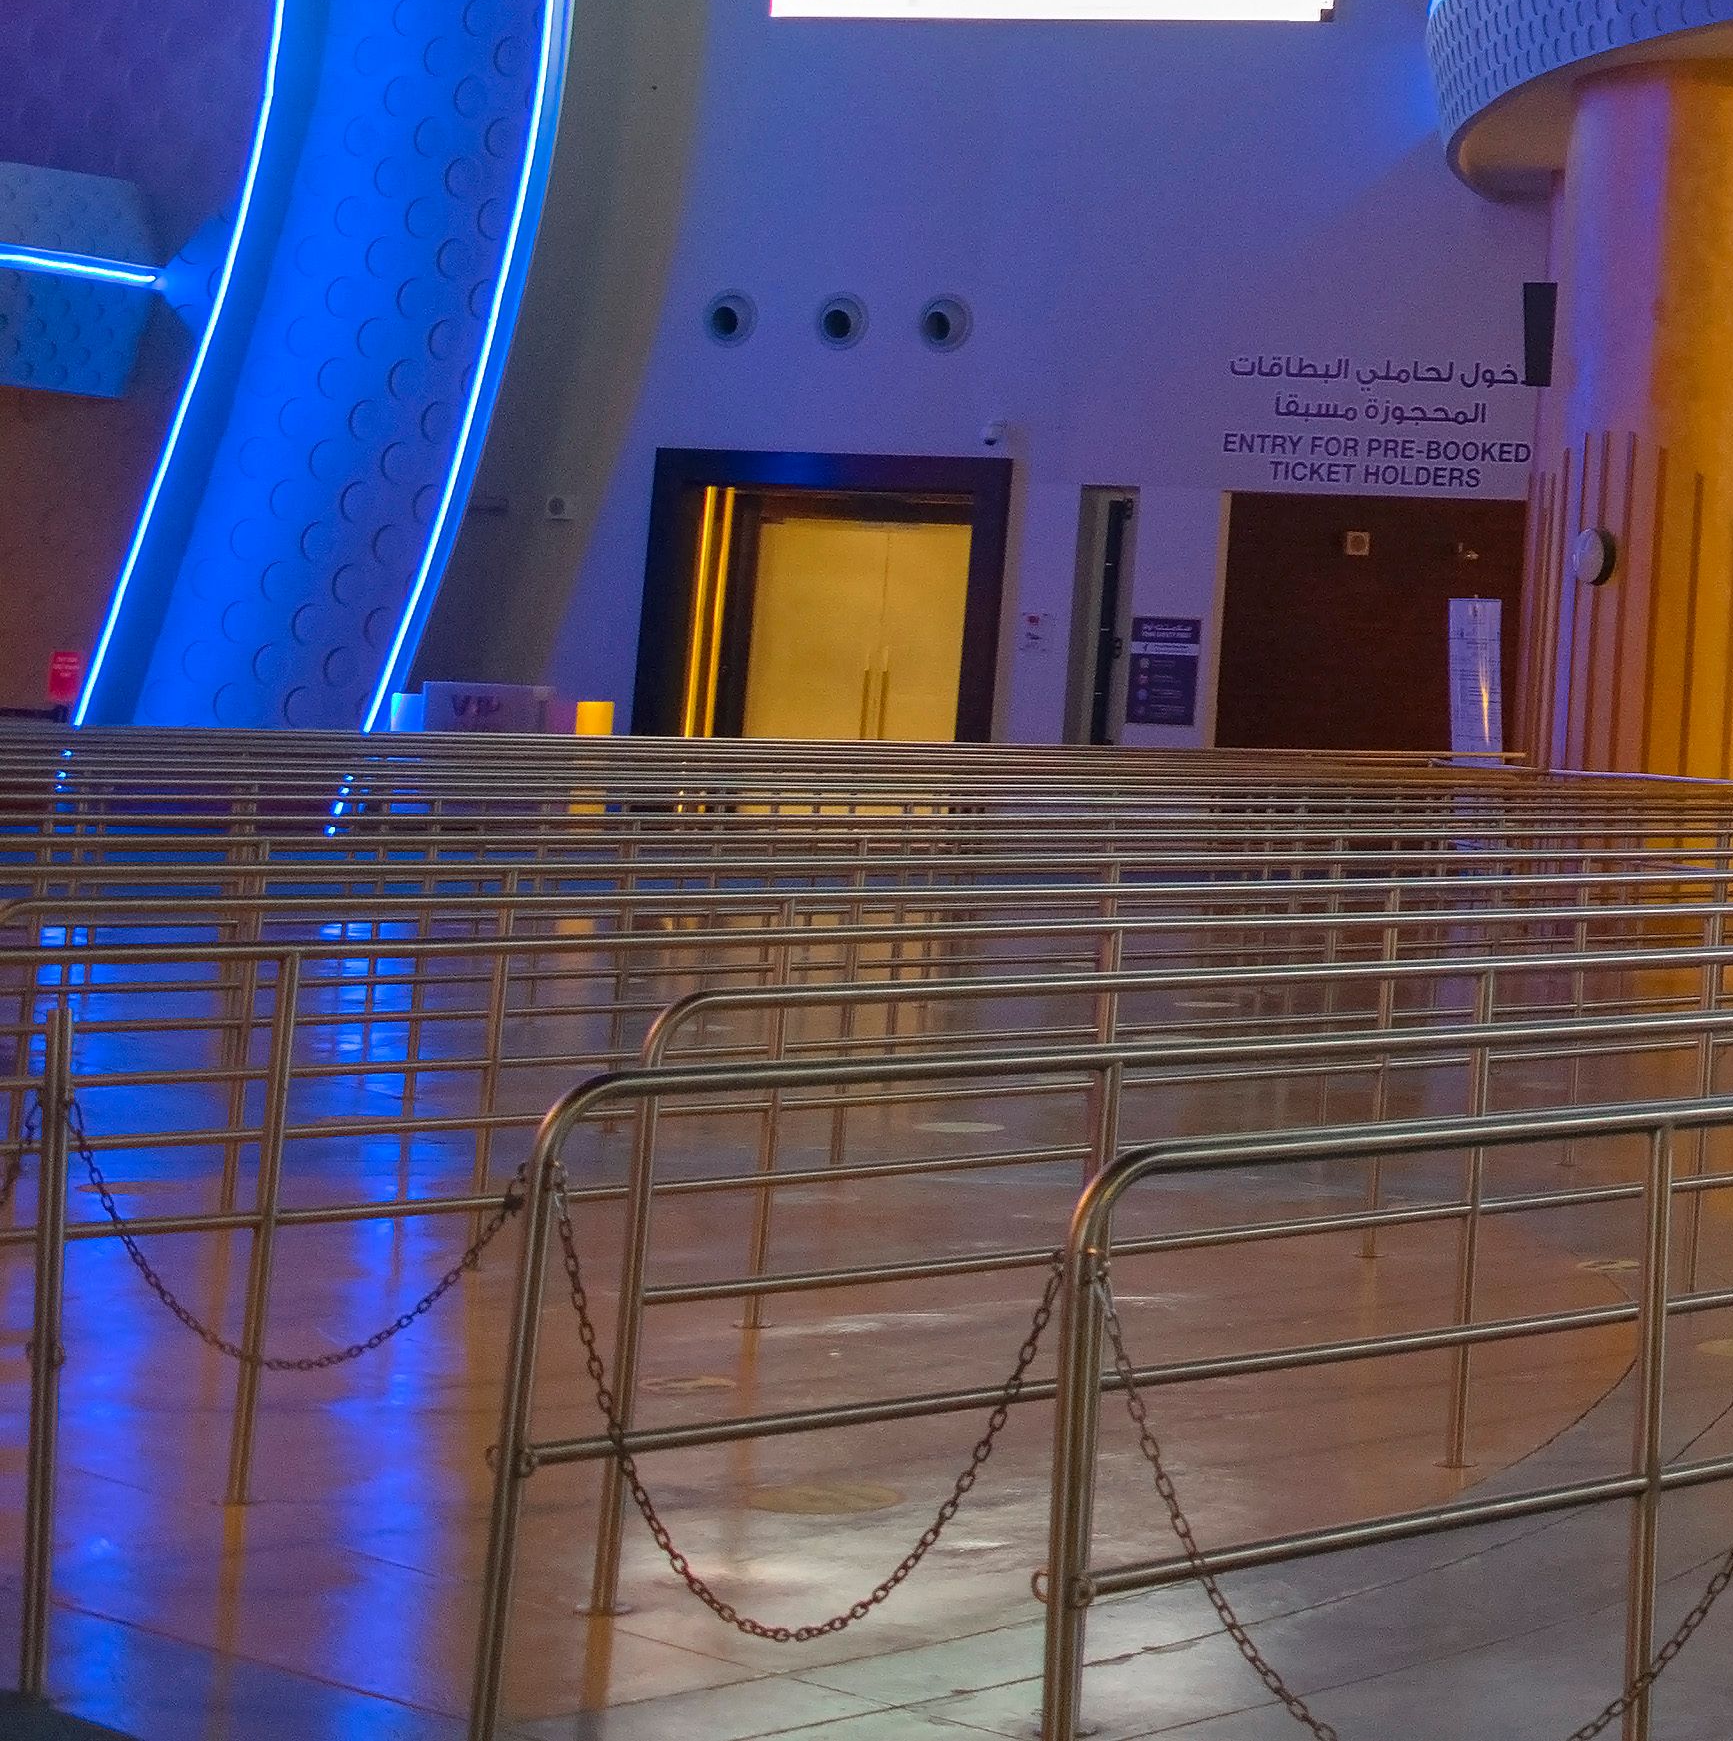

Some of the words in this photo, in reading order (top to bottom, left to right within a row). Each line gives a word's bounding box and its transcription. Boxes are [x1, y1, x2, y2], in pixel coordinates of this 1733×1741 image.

[1229, 356, 1349, 384] البطاقات
[1355, 361, 1454, 392] لحاملي
[1364, 397, 1487, 425] المحجوزة
[1223, 433, 1303, 454] ENTRY
[1309, 436, 1359, 457] FOR
[1366, 438, 1532, 463] PRE-BOOKED
[1270, 461, 1356, 483] TICKET
[1363, 464, 1481, 488] HOLDERS
